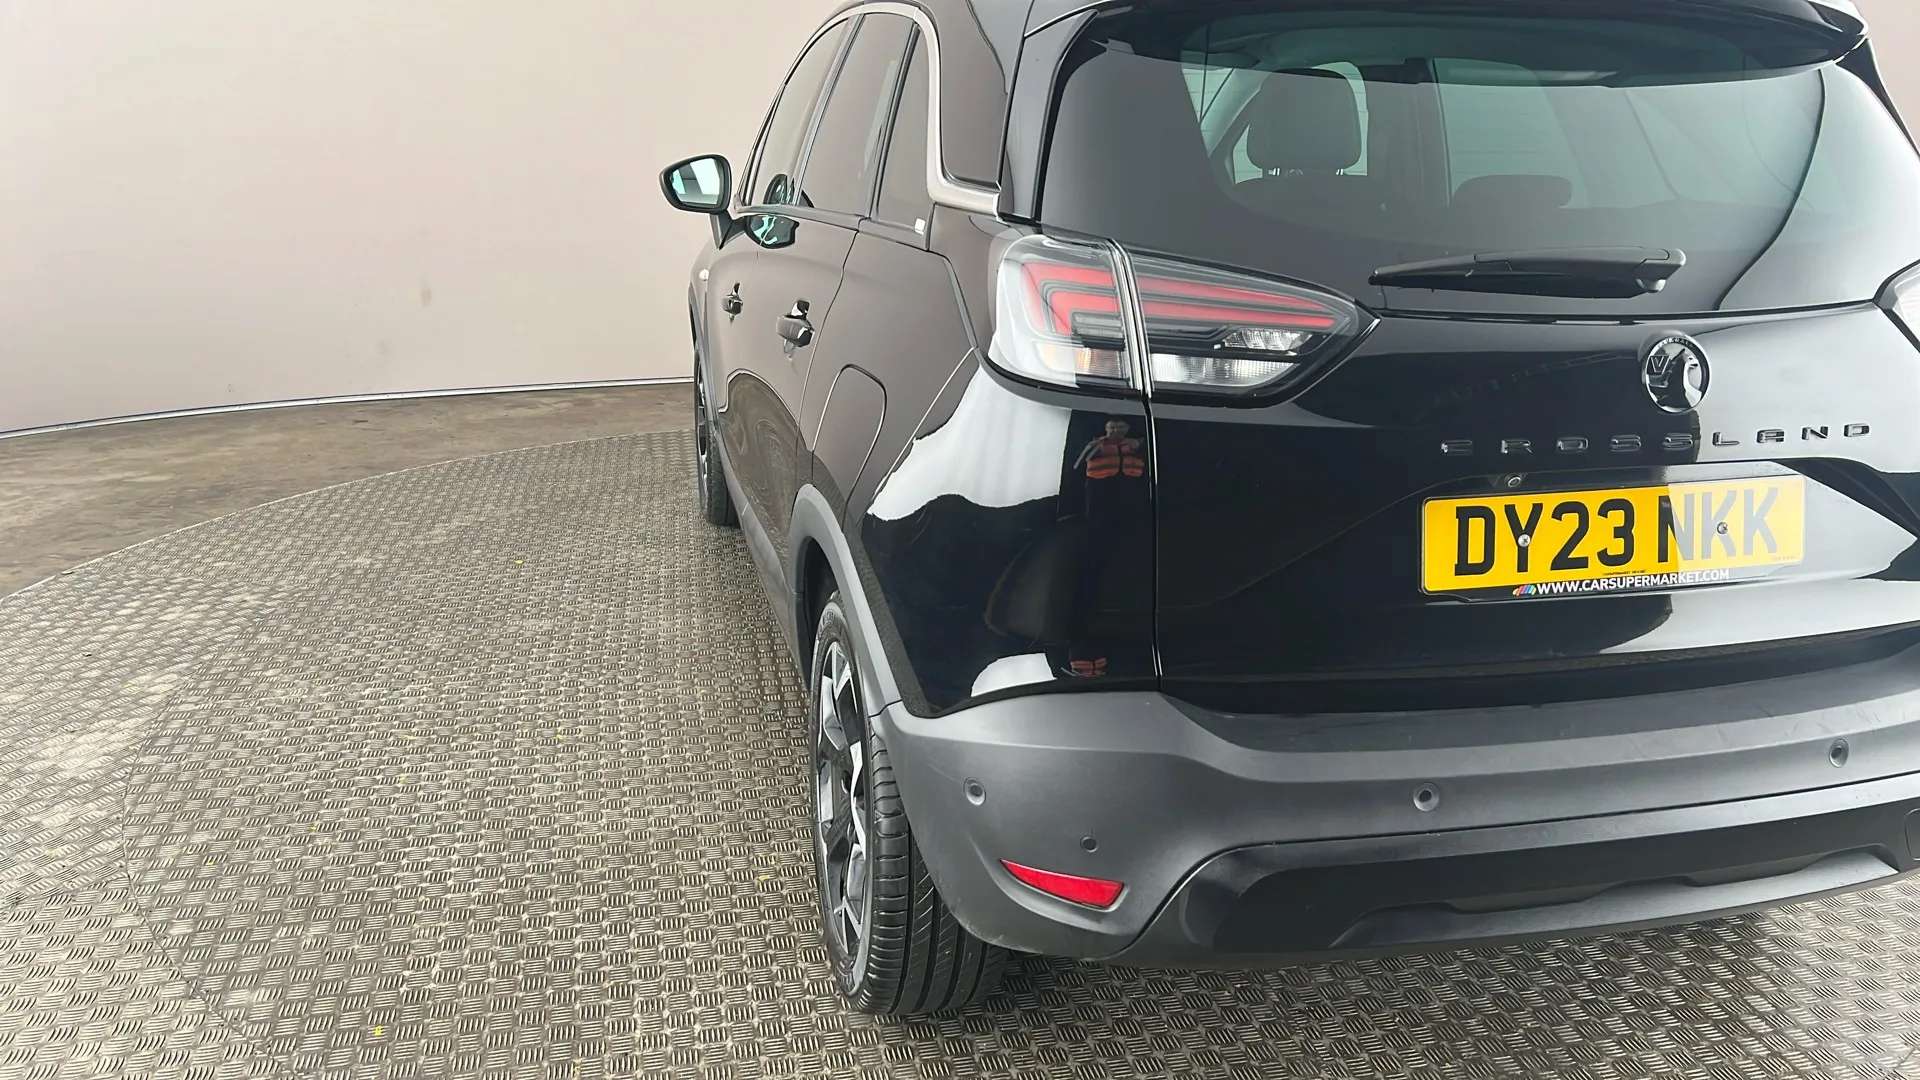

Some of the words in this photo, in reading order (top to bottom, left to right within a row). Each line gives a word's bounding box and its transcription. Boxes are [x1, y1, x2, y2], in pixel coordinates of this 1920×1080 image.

[1440, 423, 1871, 456] CROSSLAND
[1454, 498, 1637, 577] DY23
[1658, 486, 1779, 563] NKK
[1537, 569, 1730, 595] WWW.CARSUPERMARKET.COM
